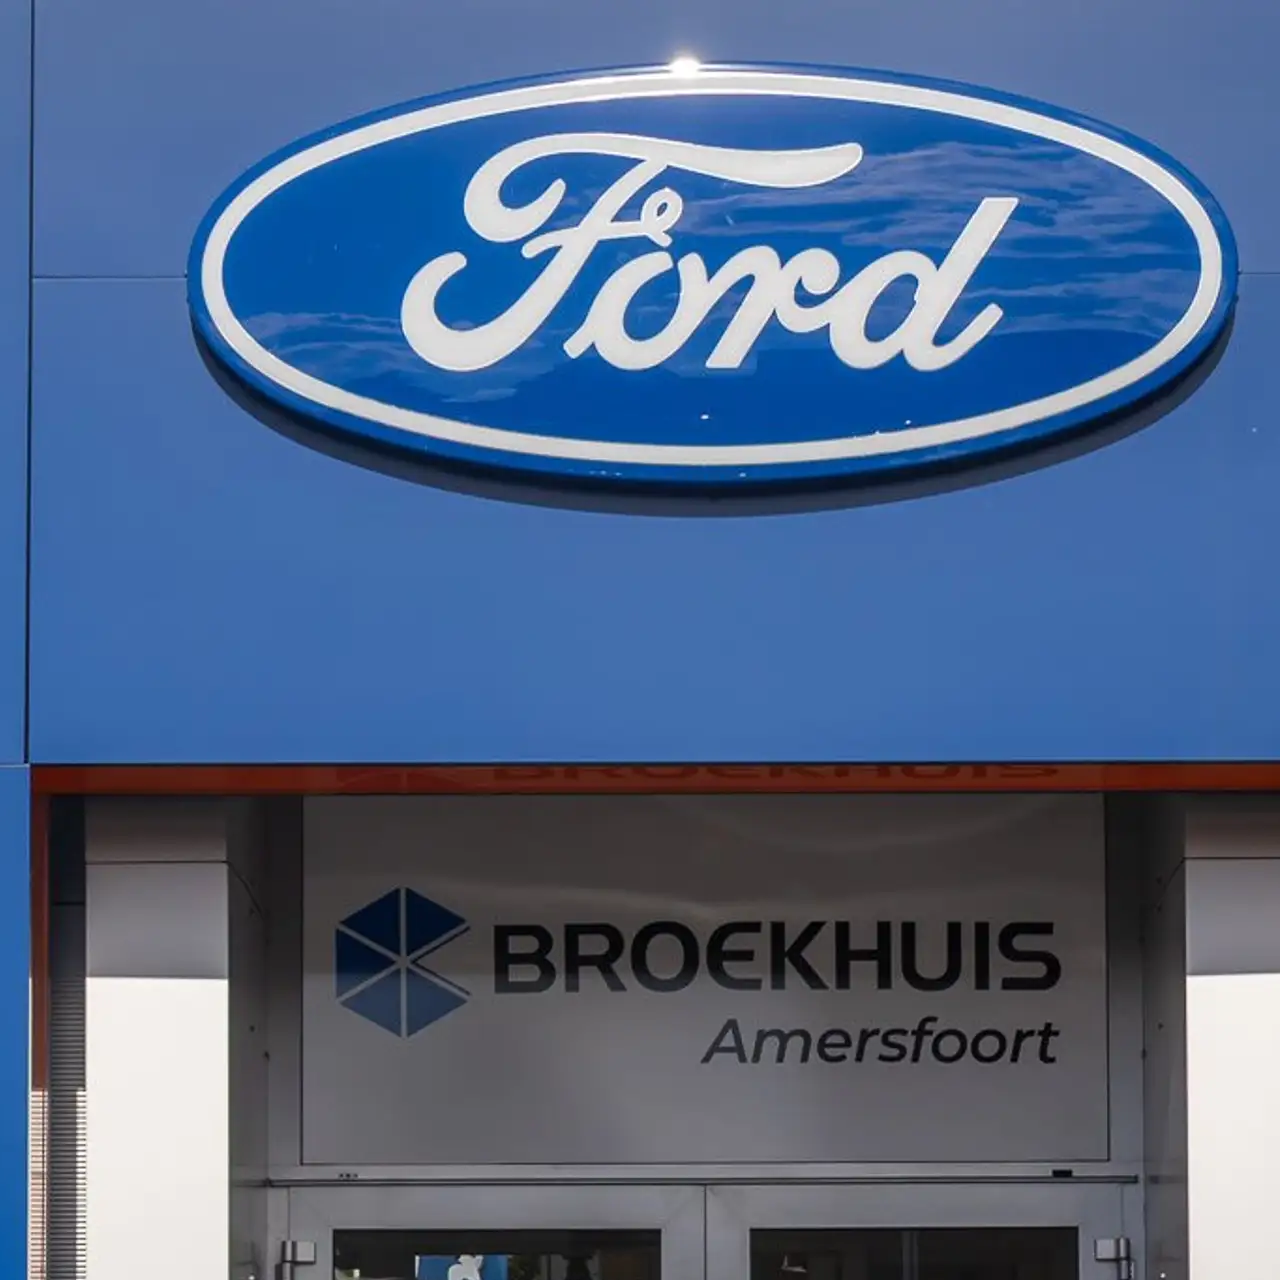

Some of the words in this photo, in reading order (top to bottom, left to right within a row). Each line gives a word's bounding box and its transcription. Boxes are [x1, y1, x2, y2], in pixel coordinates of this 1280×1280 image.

[401, 132, 1019, 372] Ford
[493, 920, 1062, 994] BROEKHUIS
[700, 1016, 1061, 1065] Amersfoort
